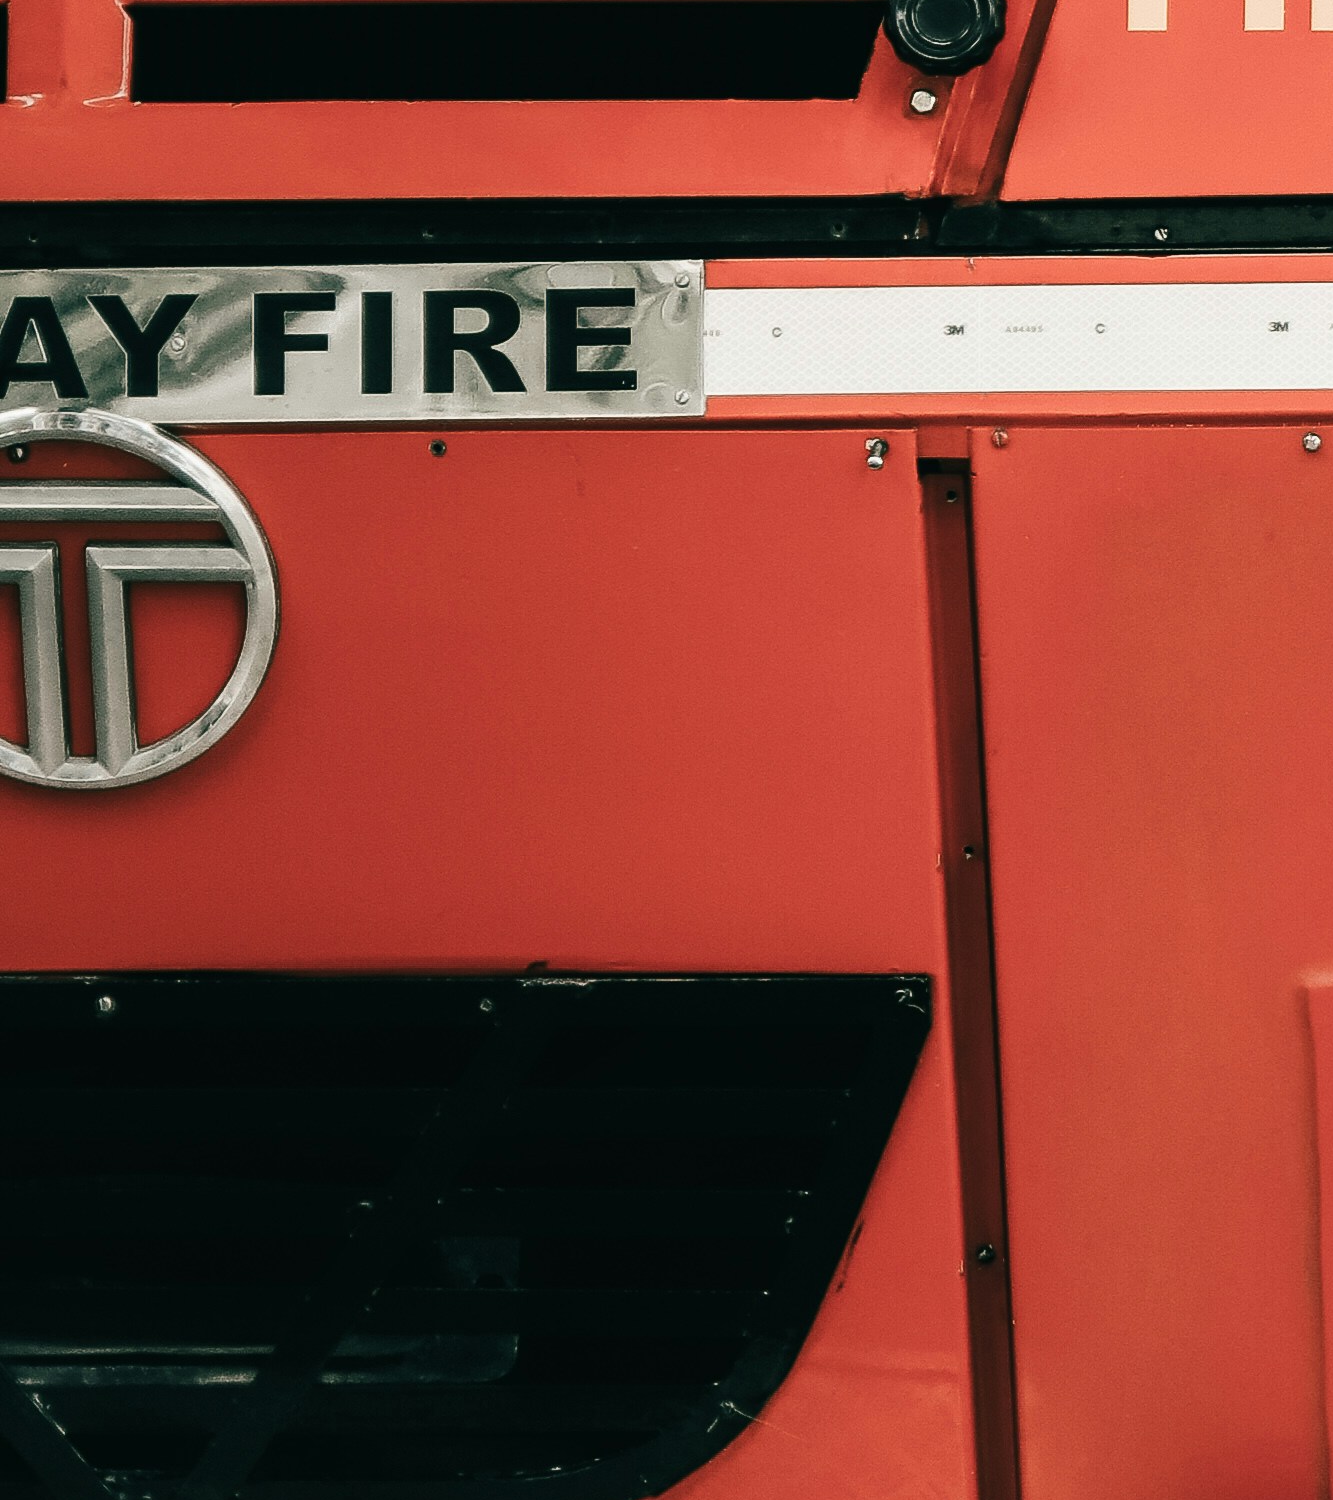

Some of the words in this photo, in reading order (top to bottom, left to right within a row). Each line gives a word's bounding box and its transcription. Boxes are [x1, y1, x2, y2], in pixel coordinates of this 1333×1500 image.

[252, 287, 638, 397] FIRE
[943, 323, 965, 336] 3M
[1268, 320, 1291, 333] 3M
